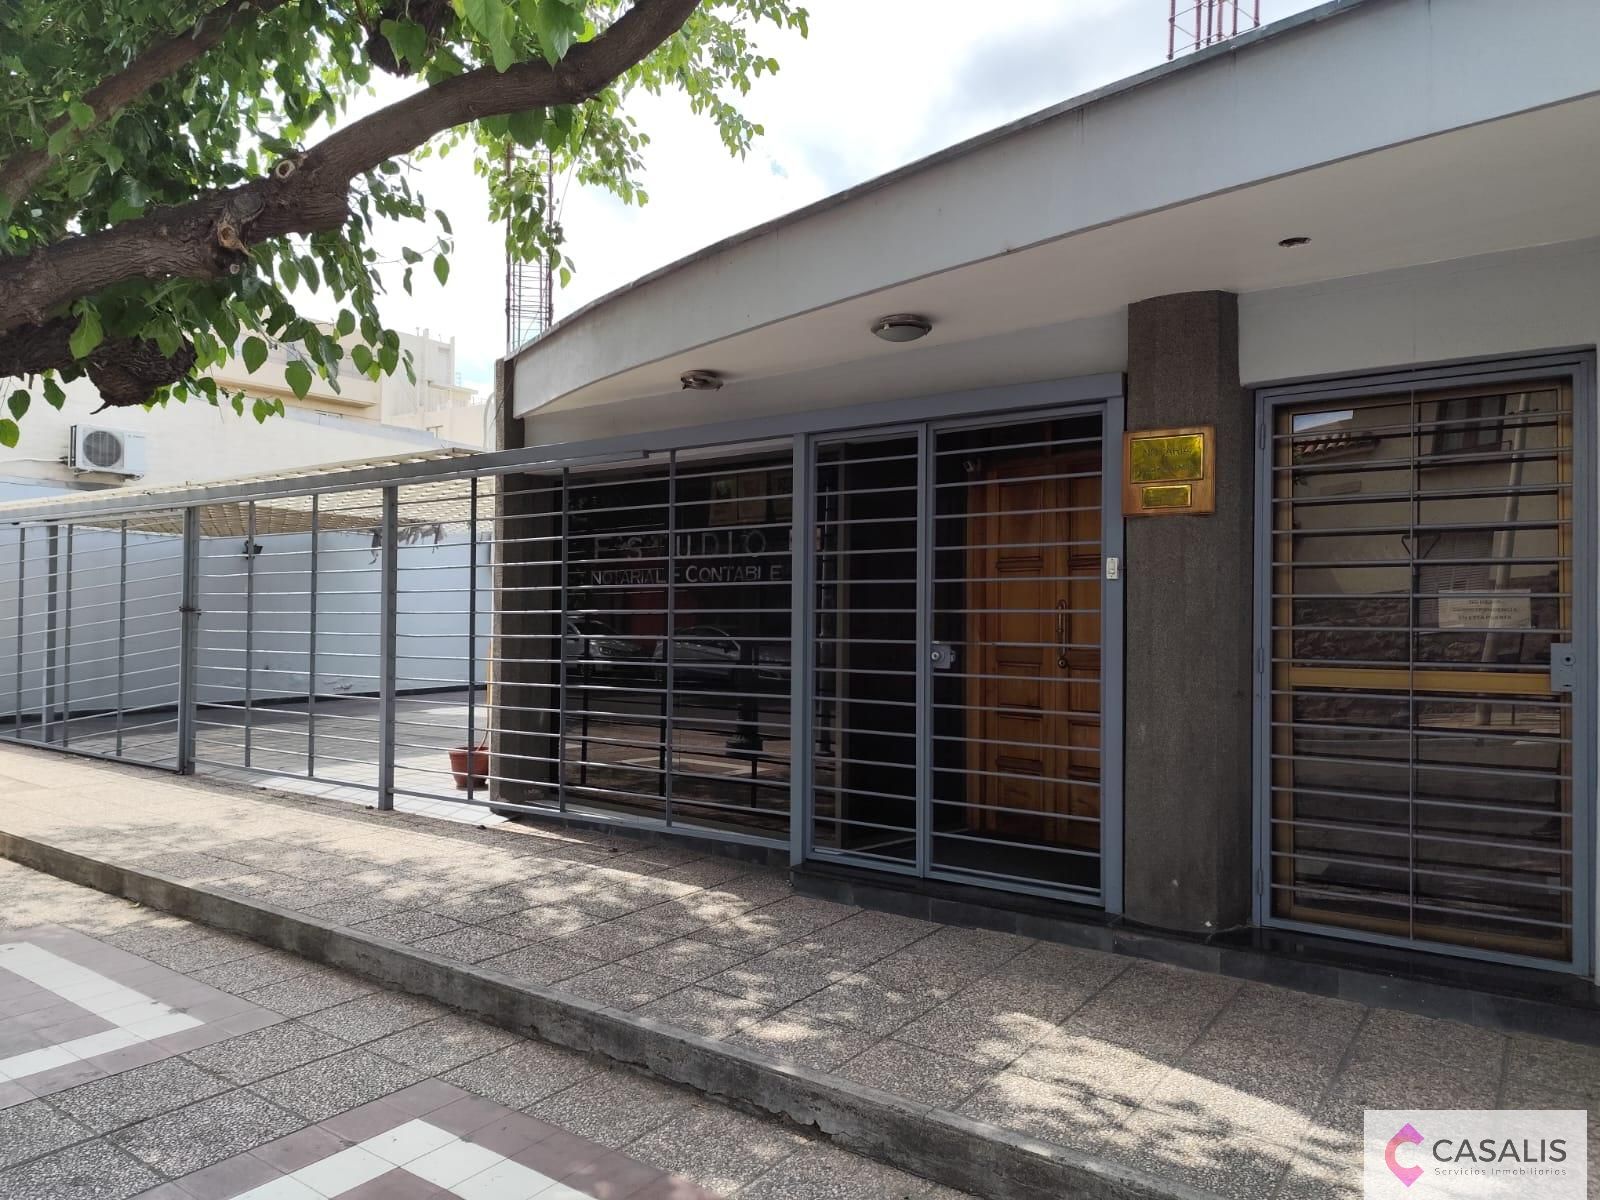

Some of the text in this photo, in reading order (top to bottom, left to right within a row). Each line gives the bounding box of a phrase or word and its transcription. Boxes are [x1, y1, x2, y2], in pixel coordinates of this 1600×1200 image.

[594, 529, 767, 560] ESUDIO
[592, 568, 667, 585] NOTARIAL
[685, 564, 783, 584] CONTABLE
